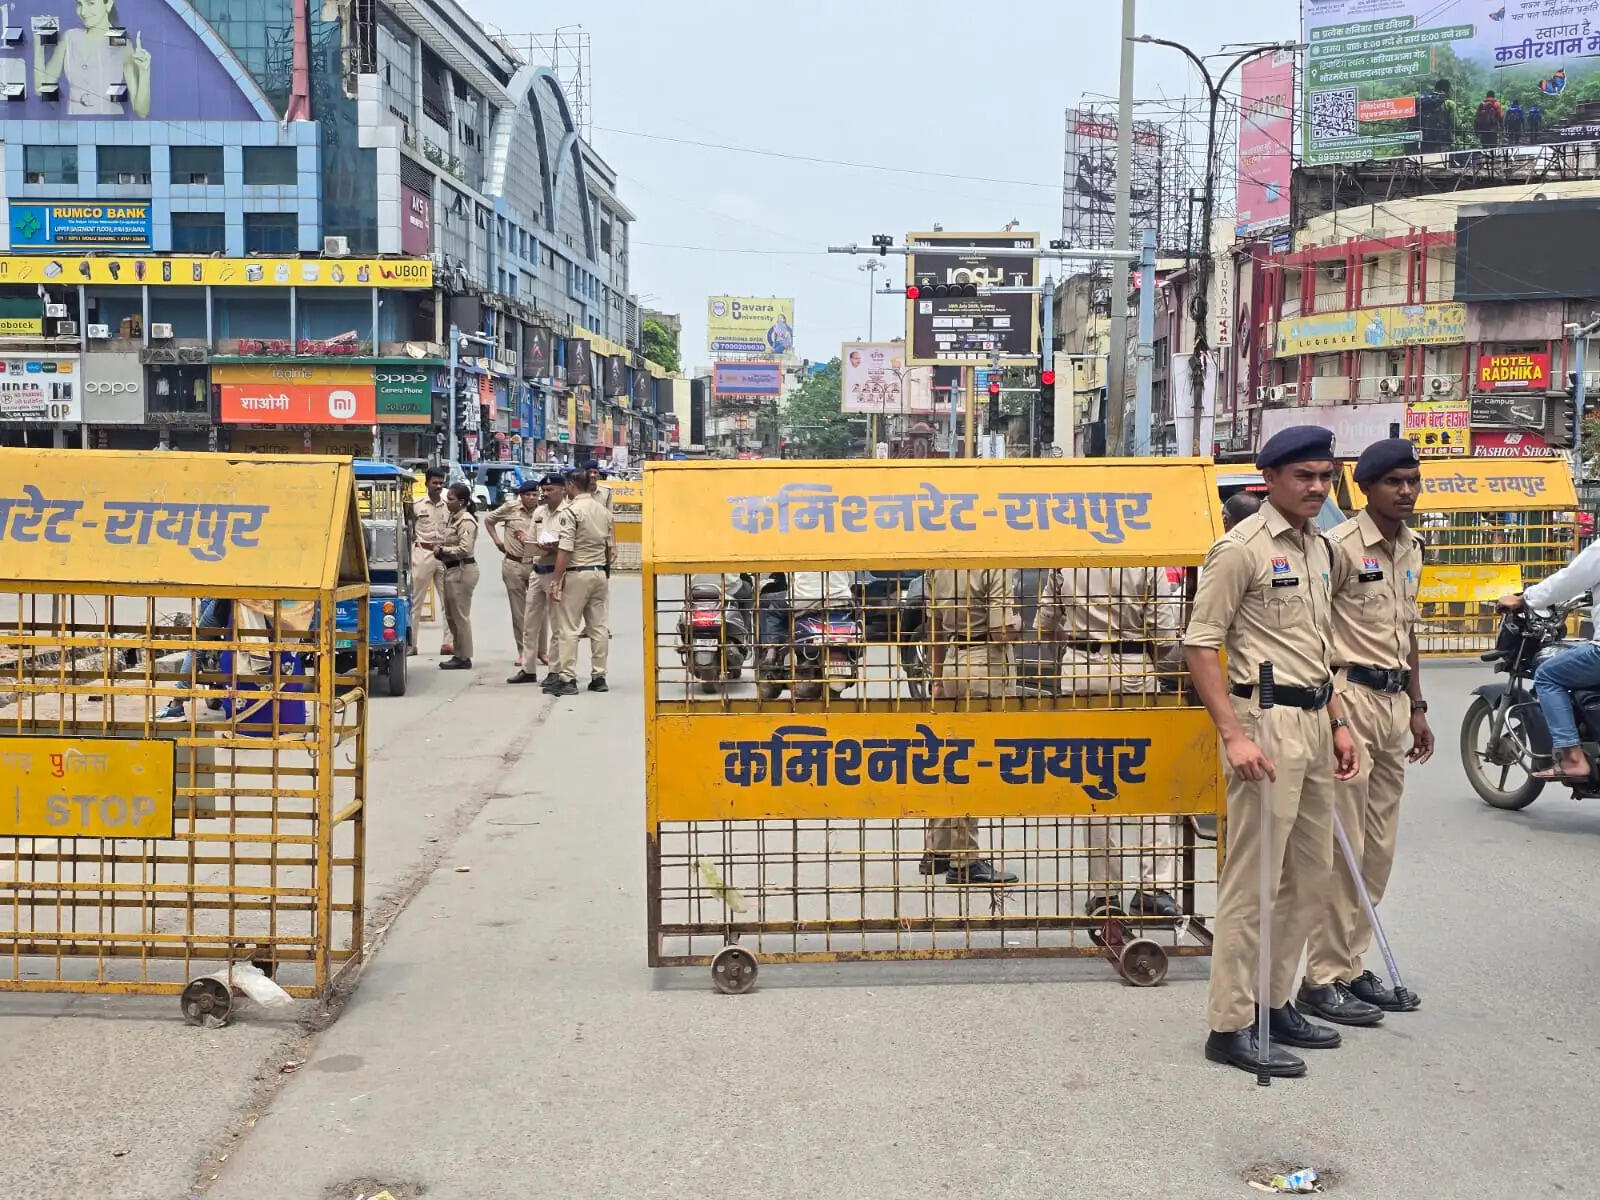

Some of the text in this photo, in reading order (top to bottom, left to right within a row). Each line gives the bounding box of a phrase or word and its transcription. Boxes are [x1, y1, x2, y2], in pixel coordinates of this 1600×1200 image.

[1535, 18, 1591, 40] स्वागत है
[1494, 37, 1583, 62] कबीरधाम
[53, 207, 147, 219] RUMCO BANK
[394, 264, 428, 278] UBON
[731, 301, 774, 312] Davara
[732, 312, 774, 322] University
[1299, 335, 1357, 348] LUGGAGE
[1490, 356, 1534, 367] HOTEL
[272, 368, 312, 379] realme
[376, 373, 428, 384] oppo
[1481, 365, 1543, 381] RADHIKA
[84, 381, 138, 396] oppo
[380, 386, 403, 394] Camera
[240, 393, 290, 411] शाओमी
[1484, 399, 1515, 407] campus
[1405, 407, 1427, 428] शिवम
[1428, 406, 1445, 429] बेल्ट
[1473, 445, 1521, 457] FASHION
[44, 793, 157, 828] STOP
